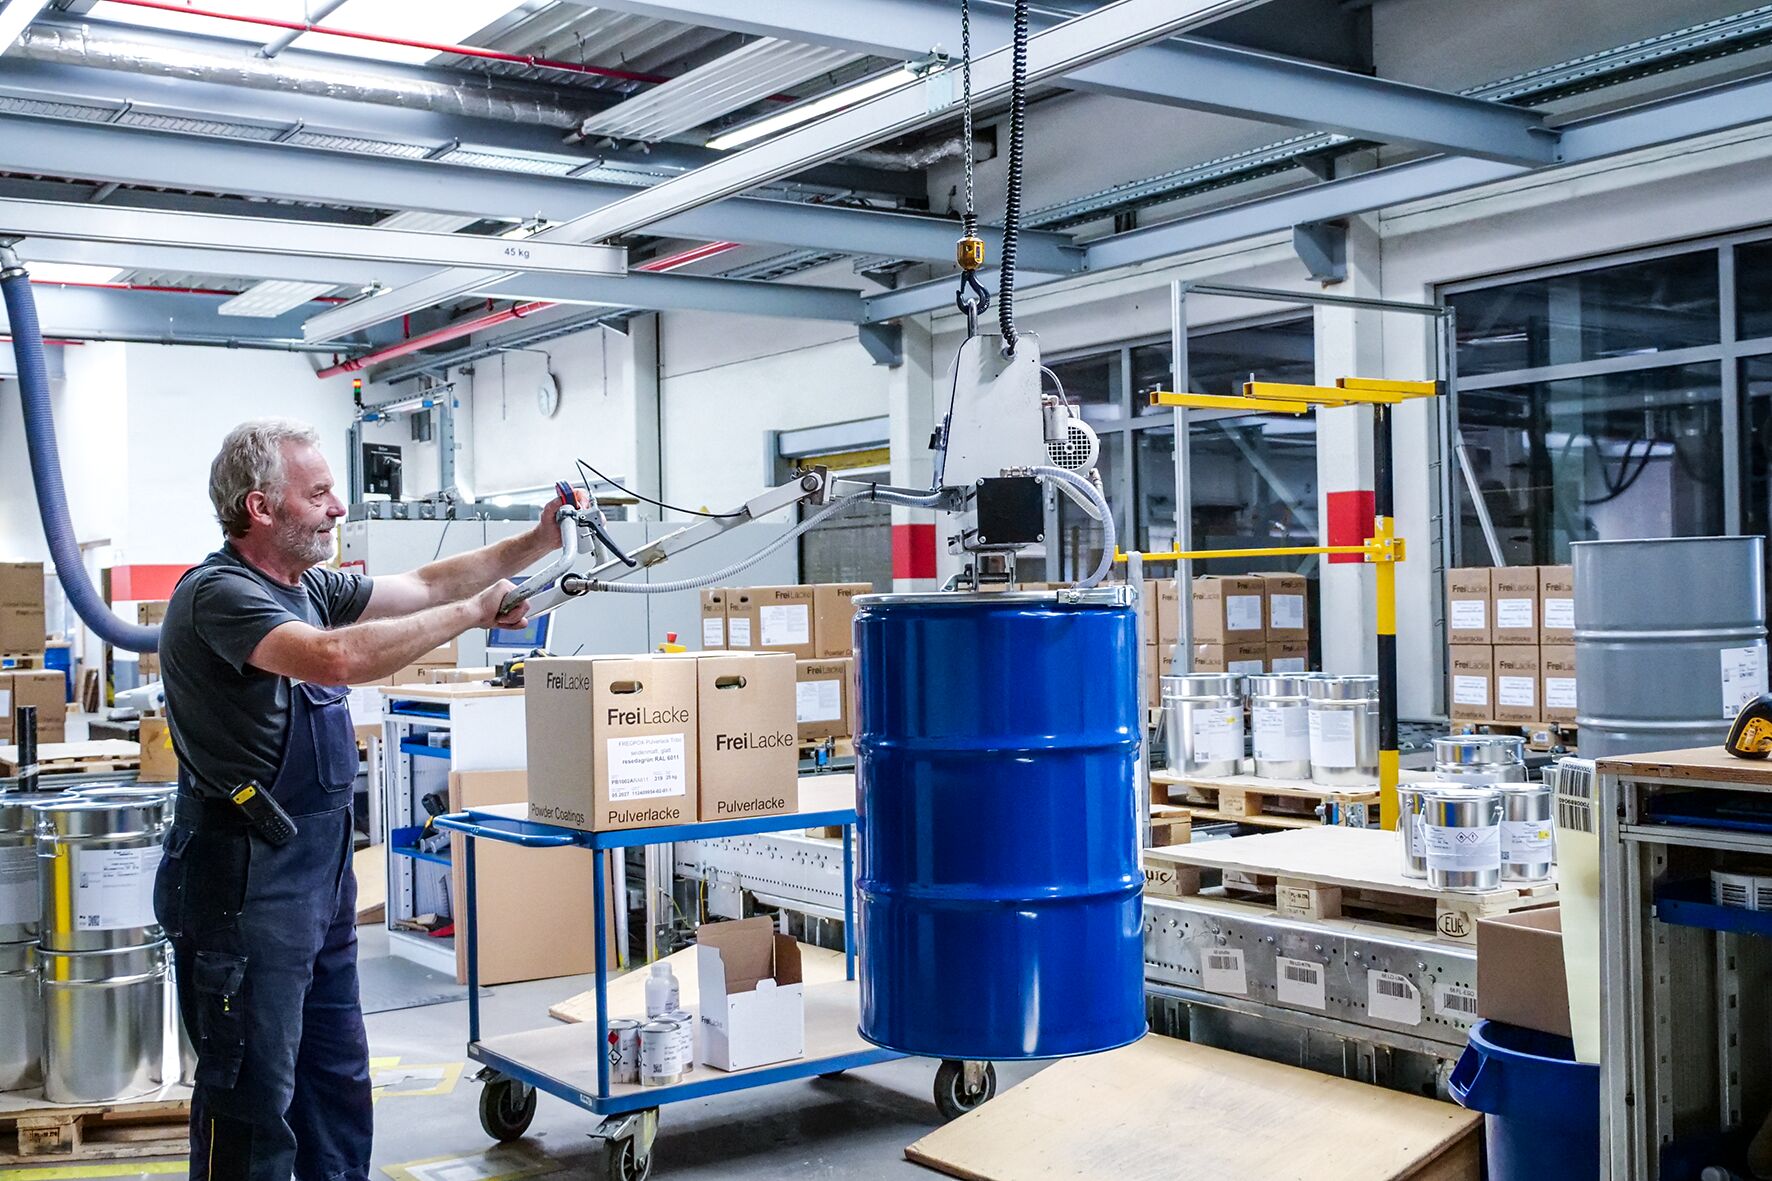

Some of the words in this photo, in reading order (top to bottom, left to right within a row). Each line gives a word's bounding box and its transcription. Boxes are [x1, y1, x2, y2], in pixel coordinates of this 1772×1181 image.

[504, 247, 516, 257] 45
[518, 248, 530, 259] kg
[547, 672, 590, 691] FreiLacke
[607, 706, 690, 726] FreiLacke
[716, 731, 793, 751] FreiLacke
[531, 803, 554, 820] Powder
[554, 806, 585, 825] Coatings
[717, 796, 785, 814] Pulverlacke
[608, 806, 680, 824] Pulverlacke
[1444, 915, 1465, 935] EUR
